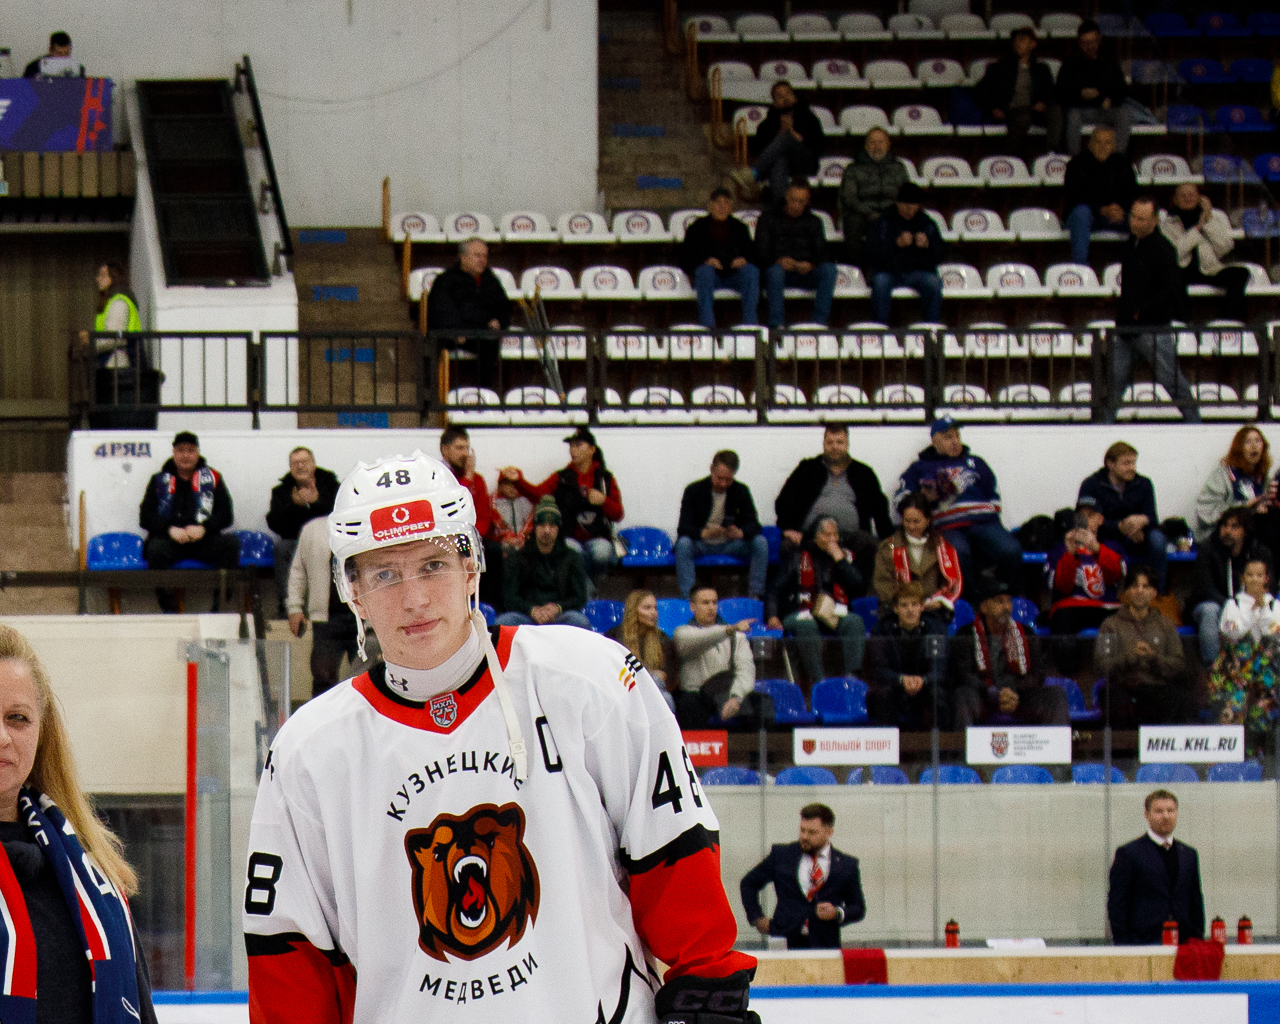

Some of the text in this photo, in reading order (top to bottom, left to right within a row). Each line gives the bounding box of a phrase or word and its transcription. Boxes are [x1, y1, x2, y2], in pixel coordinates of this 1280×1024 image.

[376, 469, 411, 488] 48
[375, 521, 431, 538] OLIMPBET
[1146, 737, 1237, 752] MHL.KHL.RU
[419, 951, 539, 1005] МЕДВЕДИ
